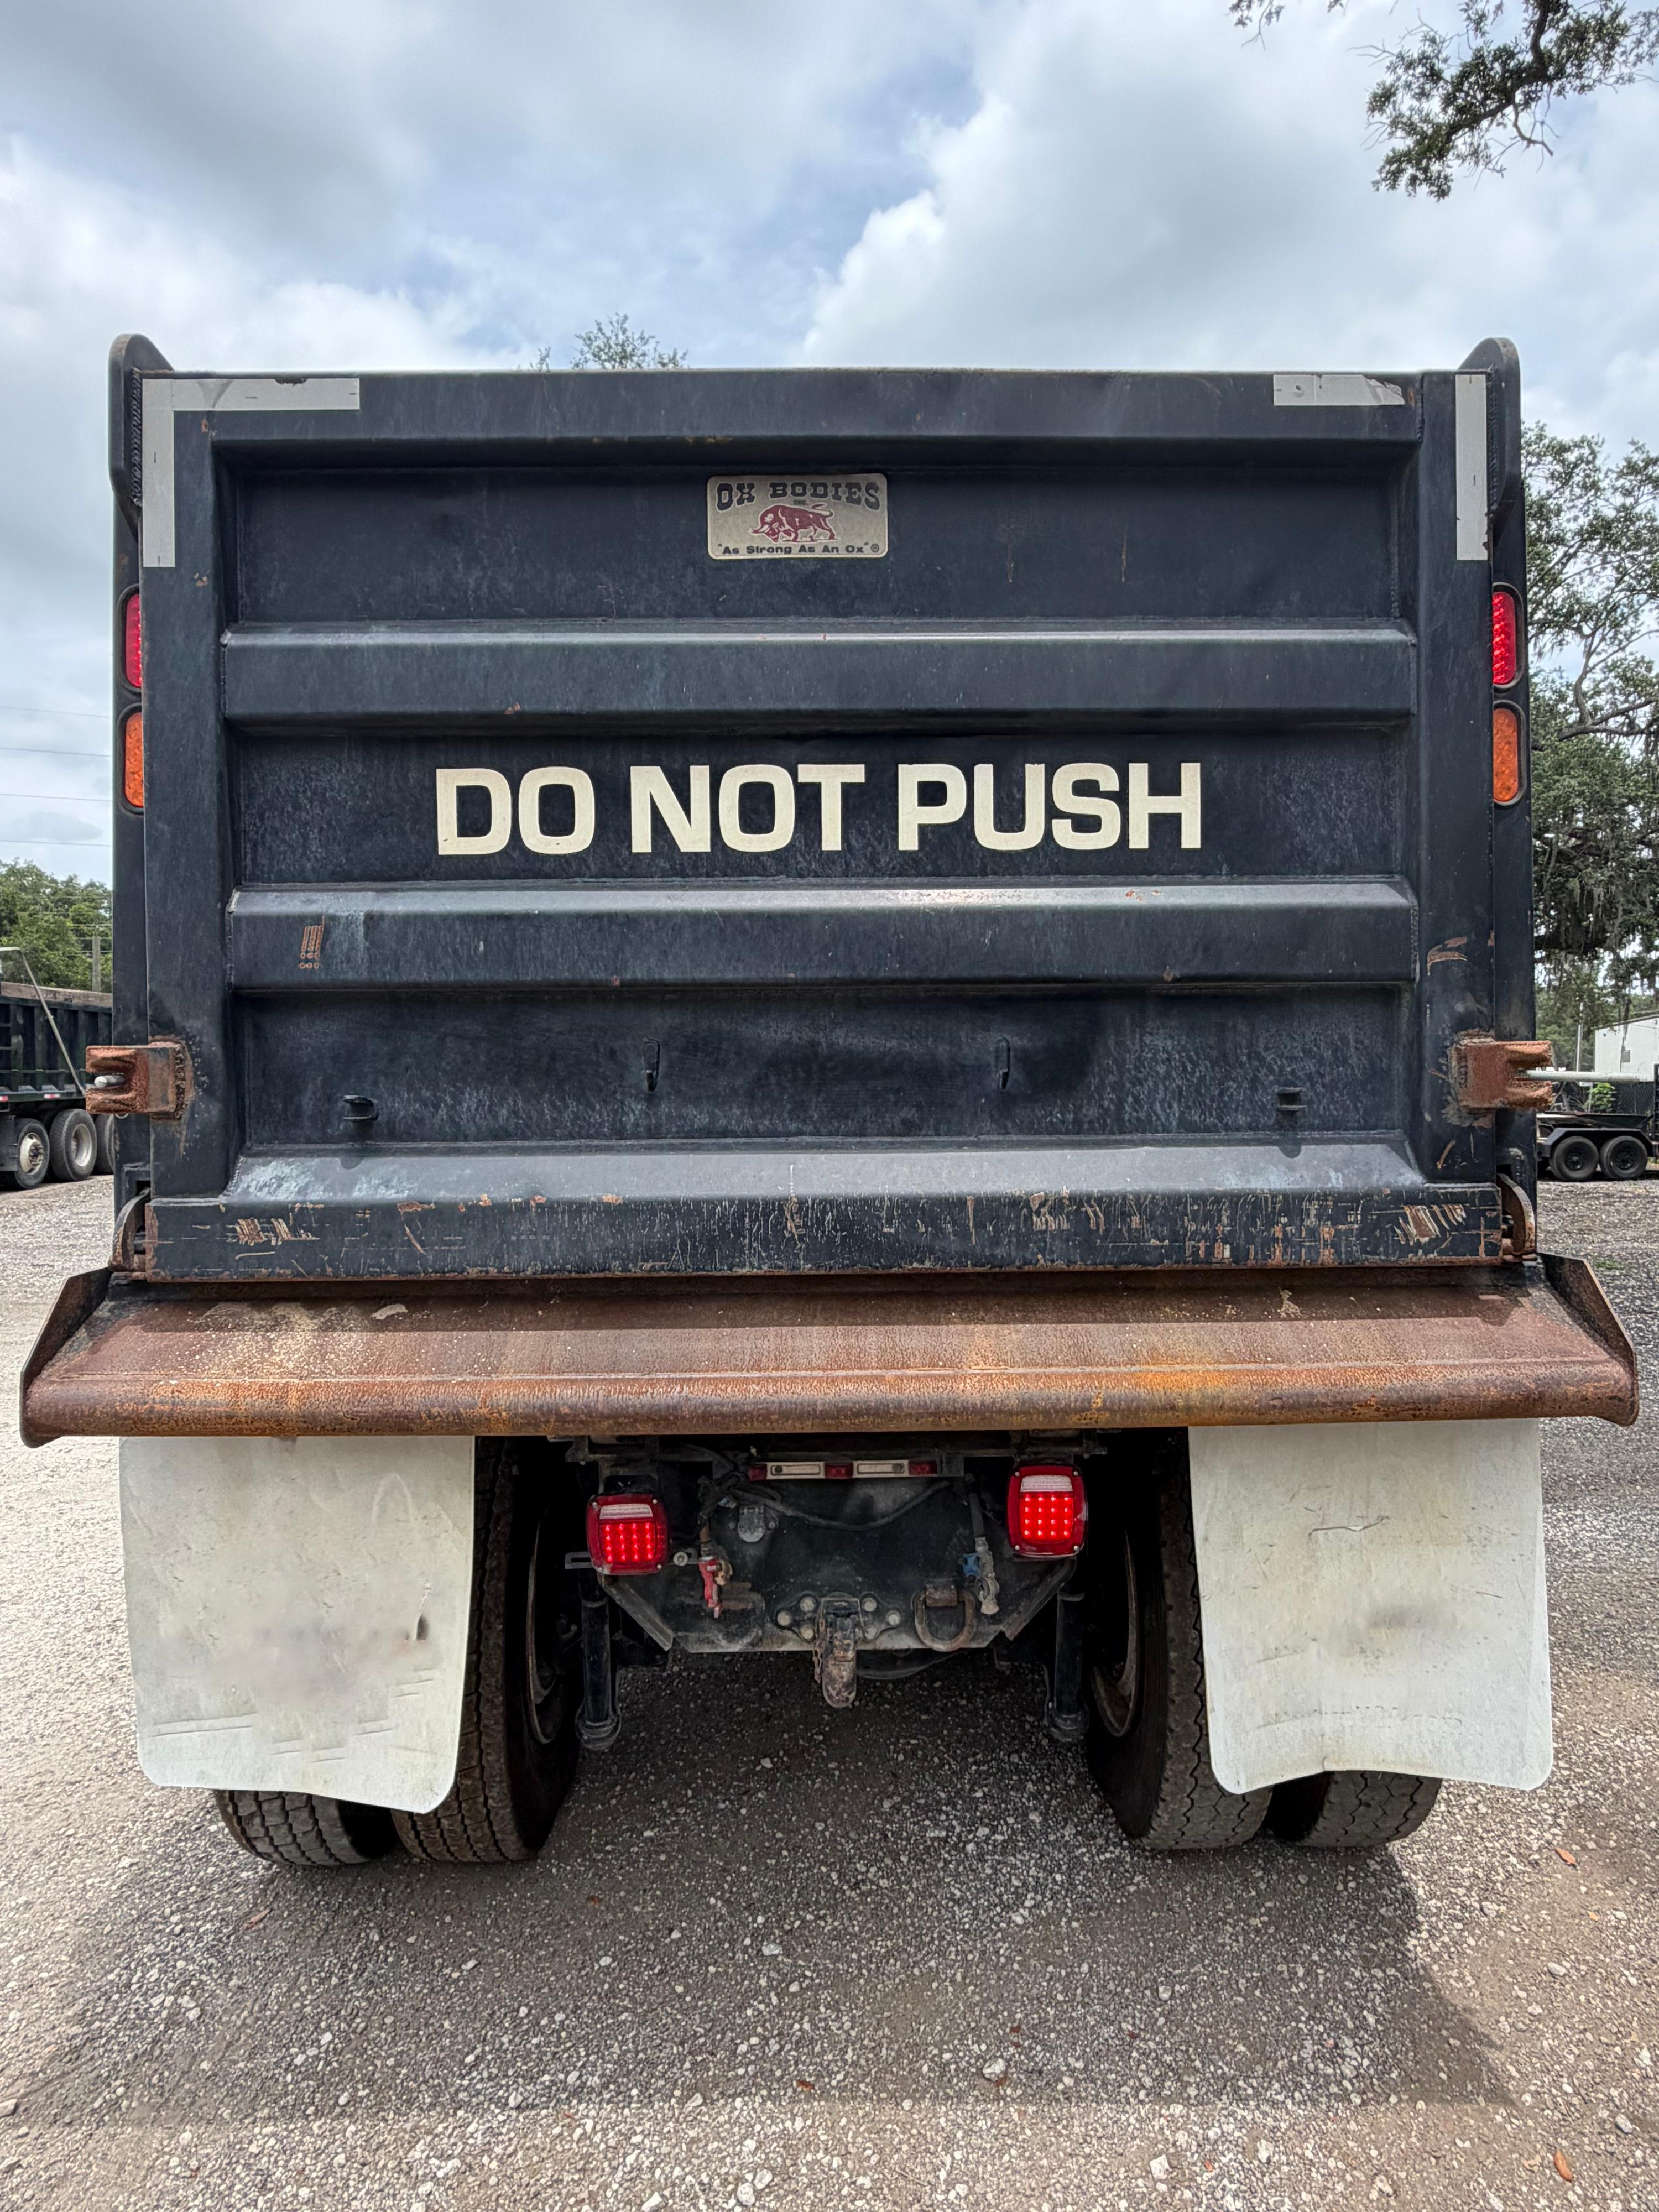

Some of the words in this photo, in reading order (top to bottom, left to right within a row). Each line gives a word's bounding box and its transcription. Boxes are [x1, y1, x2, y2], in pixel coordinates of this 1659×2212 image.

[717, 483, 755, 510] OX
[769, 482, 880, 510] BODIES
[747, 545, 792, 554] Strong
[798, 545, 816, 553] As
[822, 545, 839, 553] An
[436, 766, 595, 855] DO
[630, 764, 865, 853] NOT
[898, 763, 1201, 851] PUSH
